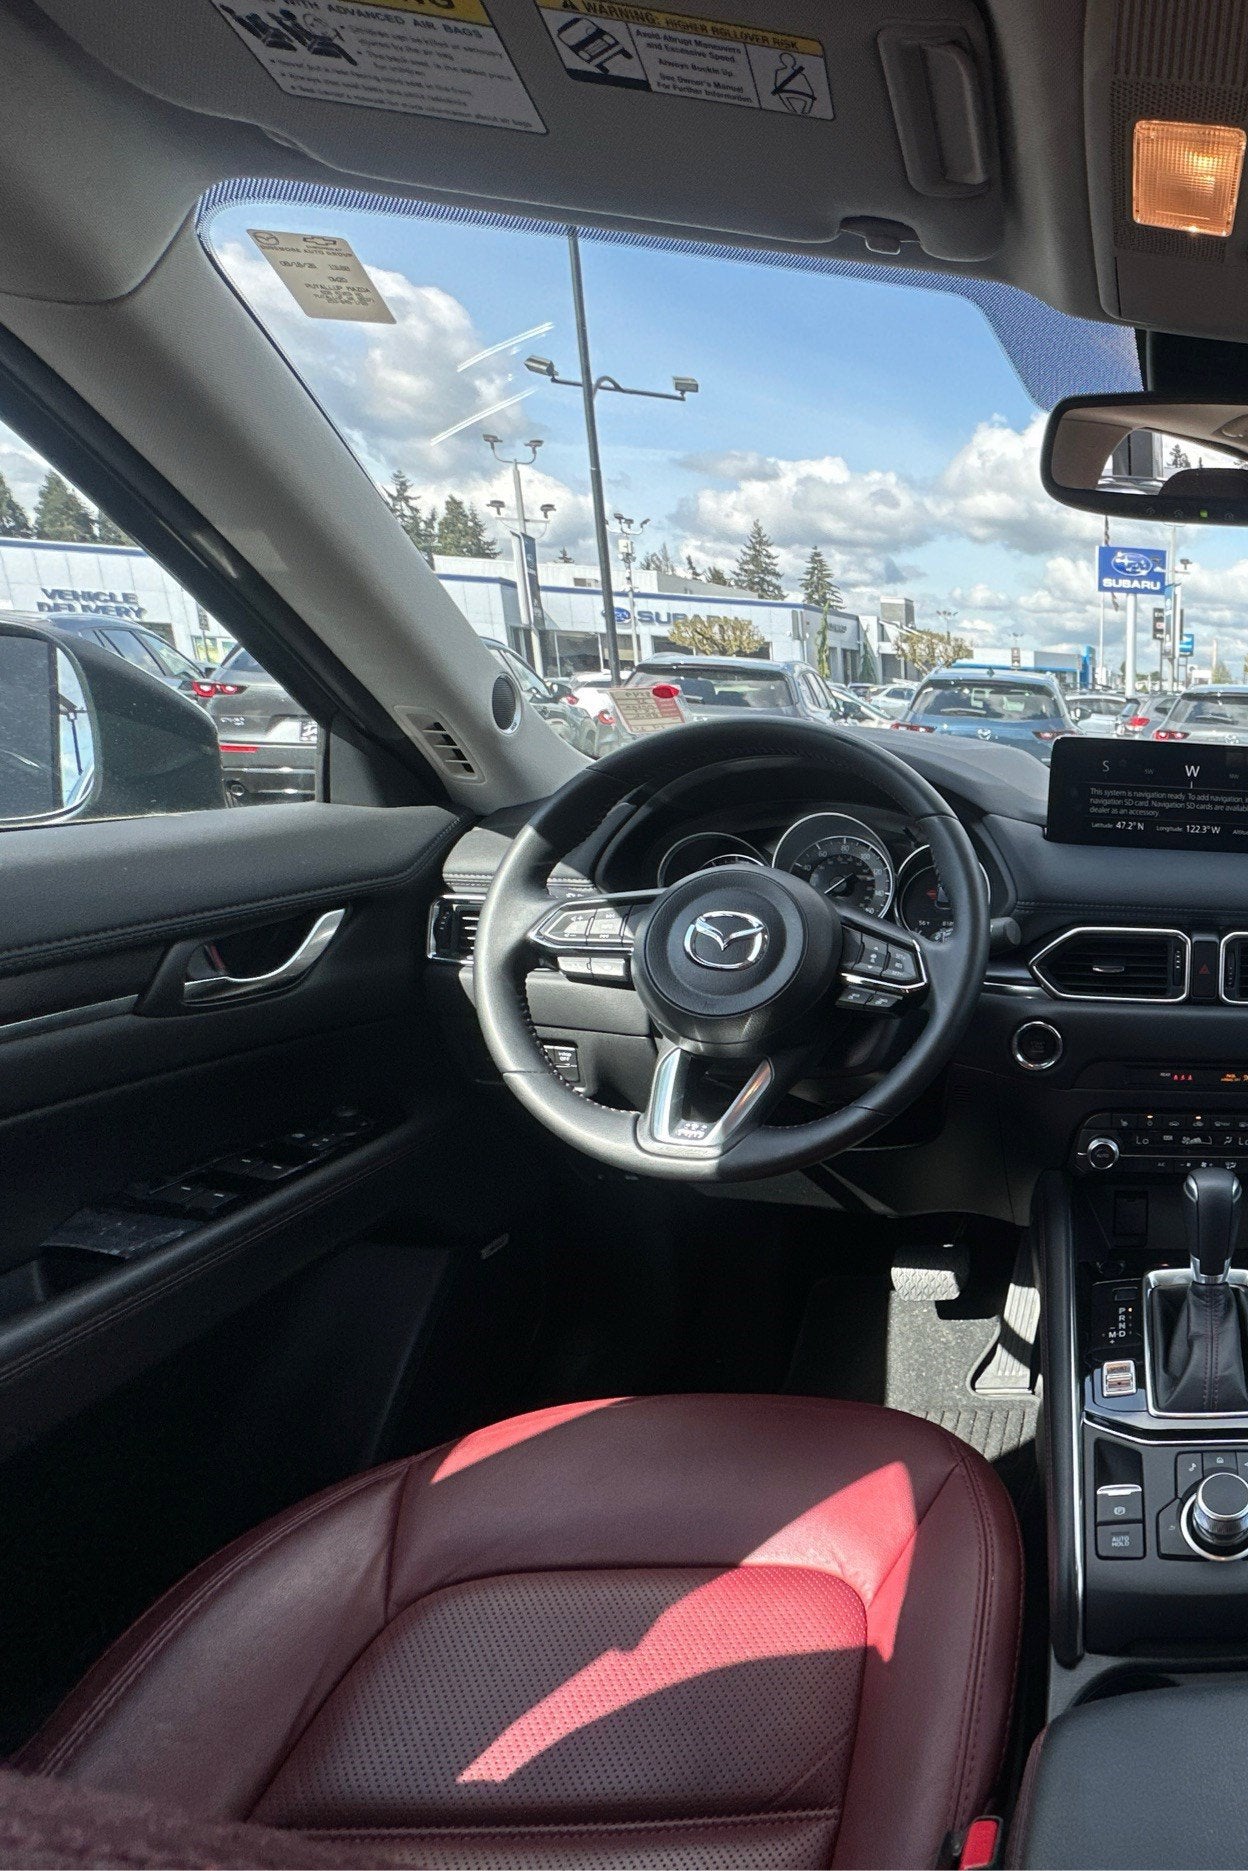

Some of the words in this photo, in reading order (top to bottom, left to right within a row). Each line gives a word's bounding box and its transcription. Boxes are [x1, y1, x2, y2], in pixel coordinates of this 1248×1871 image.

[328, 4, 406, 25] ADVANCED
[413, 18, 437, 30] AIR
[441, 23, 483, 38] BAGS
[666, 19, 708, 34] HIGHER
[711, 24, 770, 44] ROLLOVER
[773, 36, 800, 50] RISK
[636, 29, 661, 40] Avoid
[663, 34, 692, 46] Abrupt
[694, 39, 742, 54] Maneuvers
[709, 52, 736, 63] Speed
[713, 81, 744, 94] Manual
[1102, 578, 1161, 591] SUBARU
[41, 587, 138, 604] VEHICLE
[36, 601, 147, 619] DELIVERY
[1102, 760, 1110, 772] S
[1184, 765, 1201, 778] W
[1090, 787, 1103, 796] This
[1104, 789, 1127, 798] system
[1133, 791, 1167, 799] navigation
[1089, 798, 1123, 807] navigation
[1151, 800, 1185, 809] Navigation
[1195, 803, 1213, 811] cards
[1089, 806, 1110, 815] dealer
[1137, 822, 1145, 831] N
[1211, 826, 1221, 834] W
[1118, 1322, 1126, 1330] N
[1108, 1331, 1117, 1339] M
[1118, 1330, 1127, 1338] D
